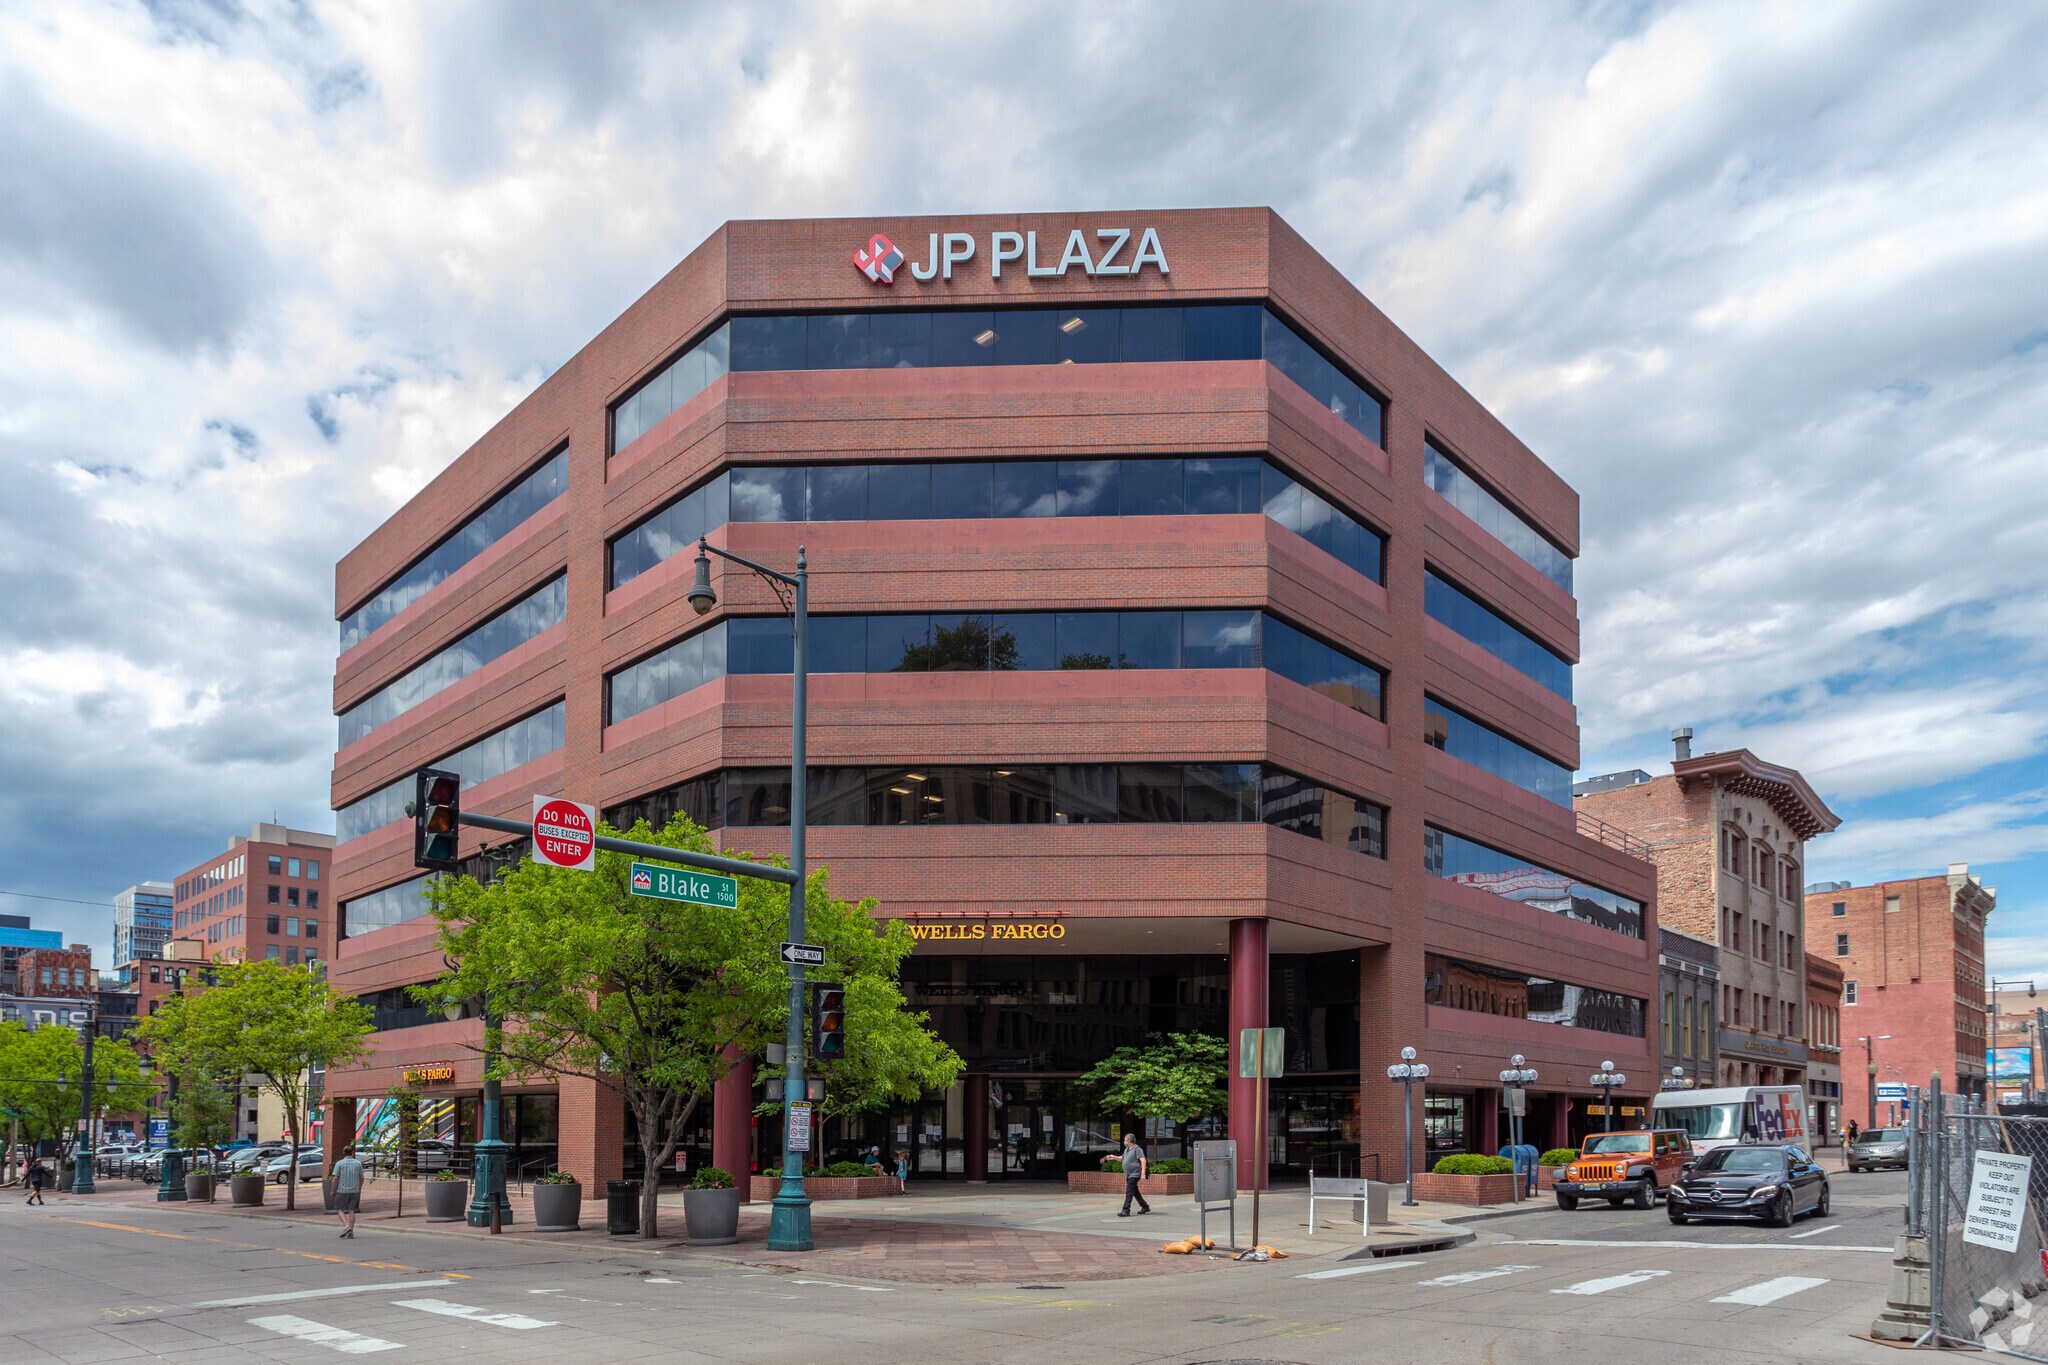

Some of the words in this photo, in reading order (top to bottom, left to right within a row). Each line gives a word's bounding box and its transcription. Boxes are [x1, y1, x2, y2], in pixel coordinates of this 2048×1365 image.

[911, 232, 976, 281] JP
[991, 228, 1170, 280] PLAZA
[543, 809, 558, 822] DO
[564, 813, 586, 827] NOT
[539, 825, 559, 837] BUSES
[561, 829, 589, 842] EXCEPTED
[546, 840, 581, 856] ENTER
[658, 873, 710, 899] Blake
[721, 883, 729, 892] St
[717, 892, 734, 902] 1500
[908, 924, 985, 940] WELLS
[991, 923, 1065, 939] FARGO
[793, 950, 806, 959] ONE
[807, 951, 820, 960] WAY
[427, 1067, 452, 1080] FARGO
[1756, 1093, 1803, 1142] FedEx
[1977, 1157, 1998, 1168] PRIVATE
[1988, 1171, 2003, 1180] KEEP
[2003, 1173, 2015, 1181] OUT
[1979, 1181, 2008, 1193] VIOLATORS
[2008, 1186, 2020, 1195] ARE
[1980, 1193, 2005, 1205] SUBJECT
[2006, 1196, 2014, 1206] TO
[1978, 1205, 2000, 1215] ARREST
[2000, 1208, 2011, 1218] PER
[1968, 1214, 1989, 1225] DENVER
[1990, 1219, 2017, 1232] TRESPASS
[1967, 1226, 1997, 1239] ORDINANCE
